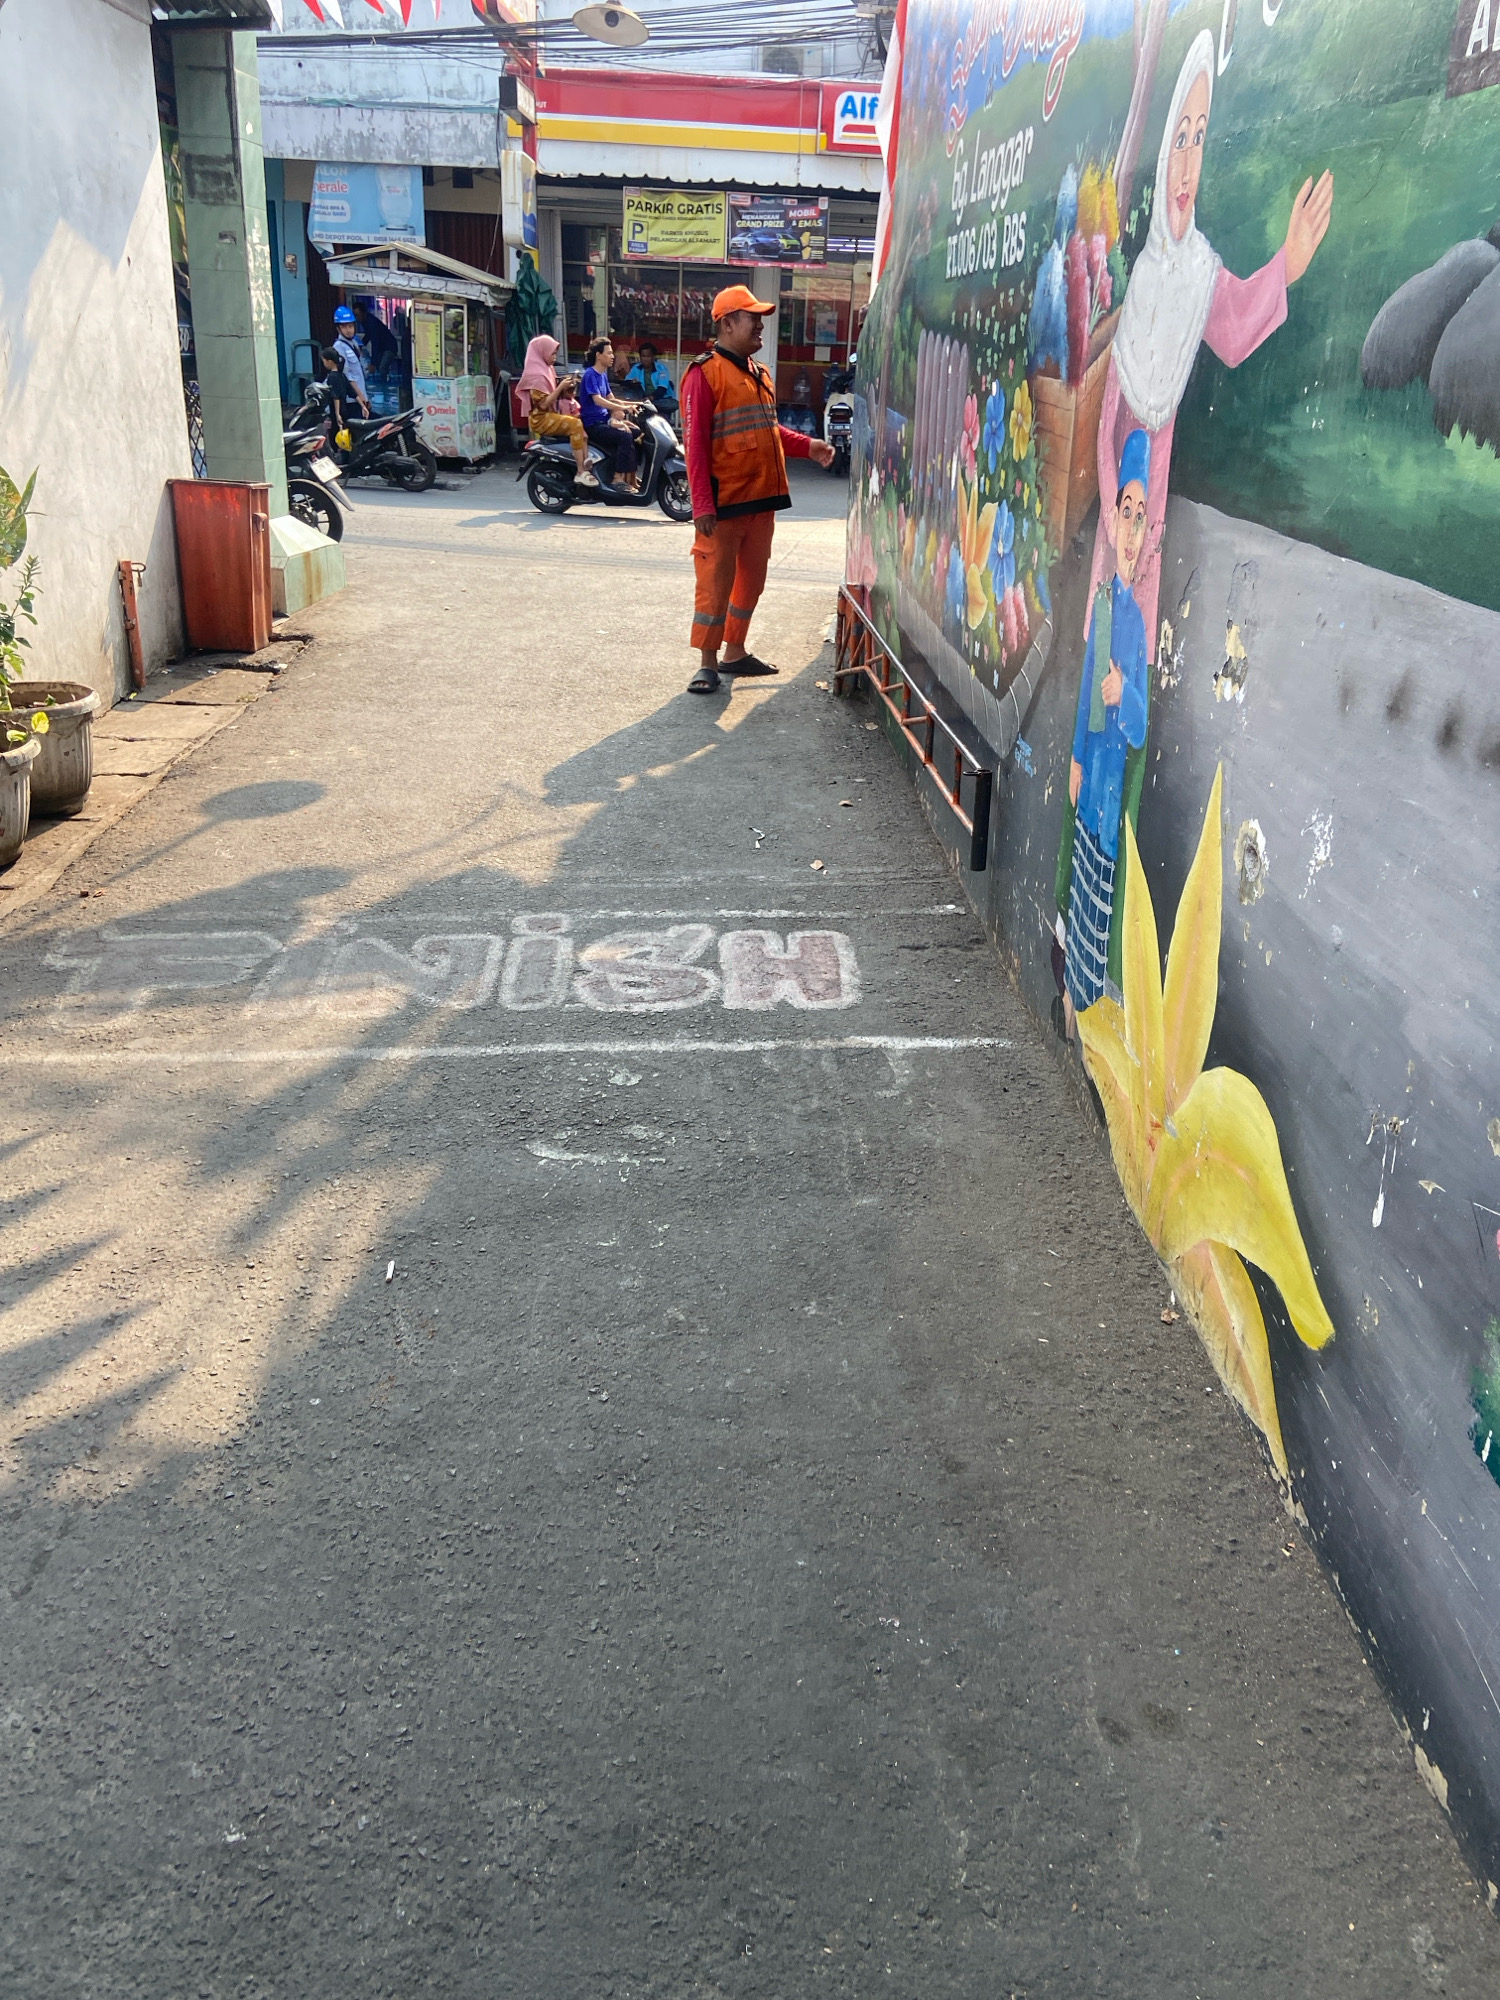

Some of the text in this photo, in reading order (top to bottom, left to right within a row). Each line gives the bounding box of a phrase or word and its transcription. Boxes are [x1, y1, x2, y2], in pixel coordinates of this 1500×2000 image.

[970, 126, 1034, 212] Langgar
[627, 199, 723, 215] PARKIR GRATIS
[788, 208, 818, 218] MOBIL
[632, 222, 644, 241] P
[735, 220, 785, 228] GRAND PRIZE
[797, 219, 824, 228] EMAS
[1001, 210, 1028, 268] RBS
